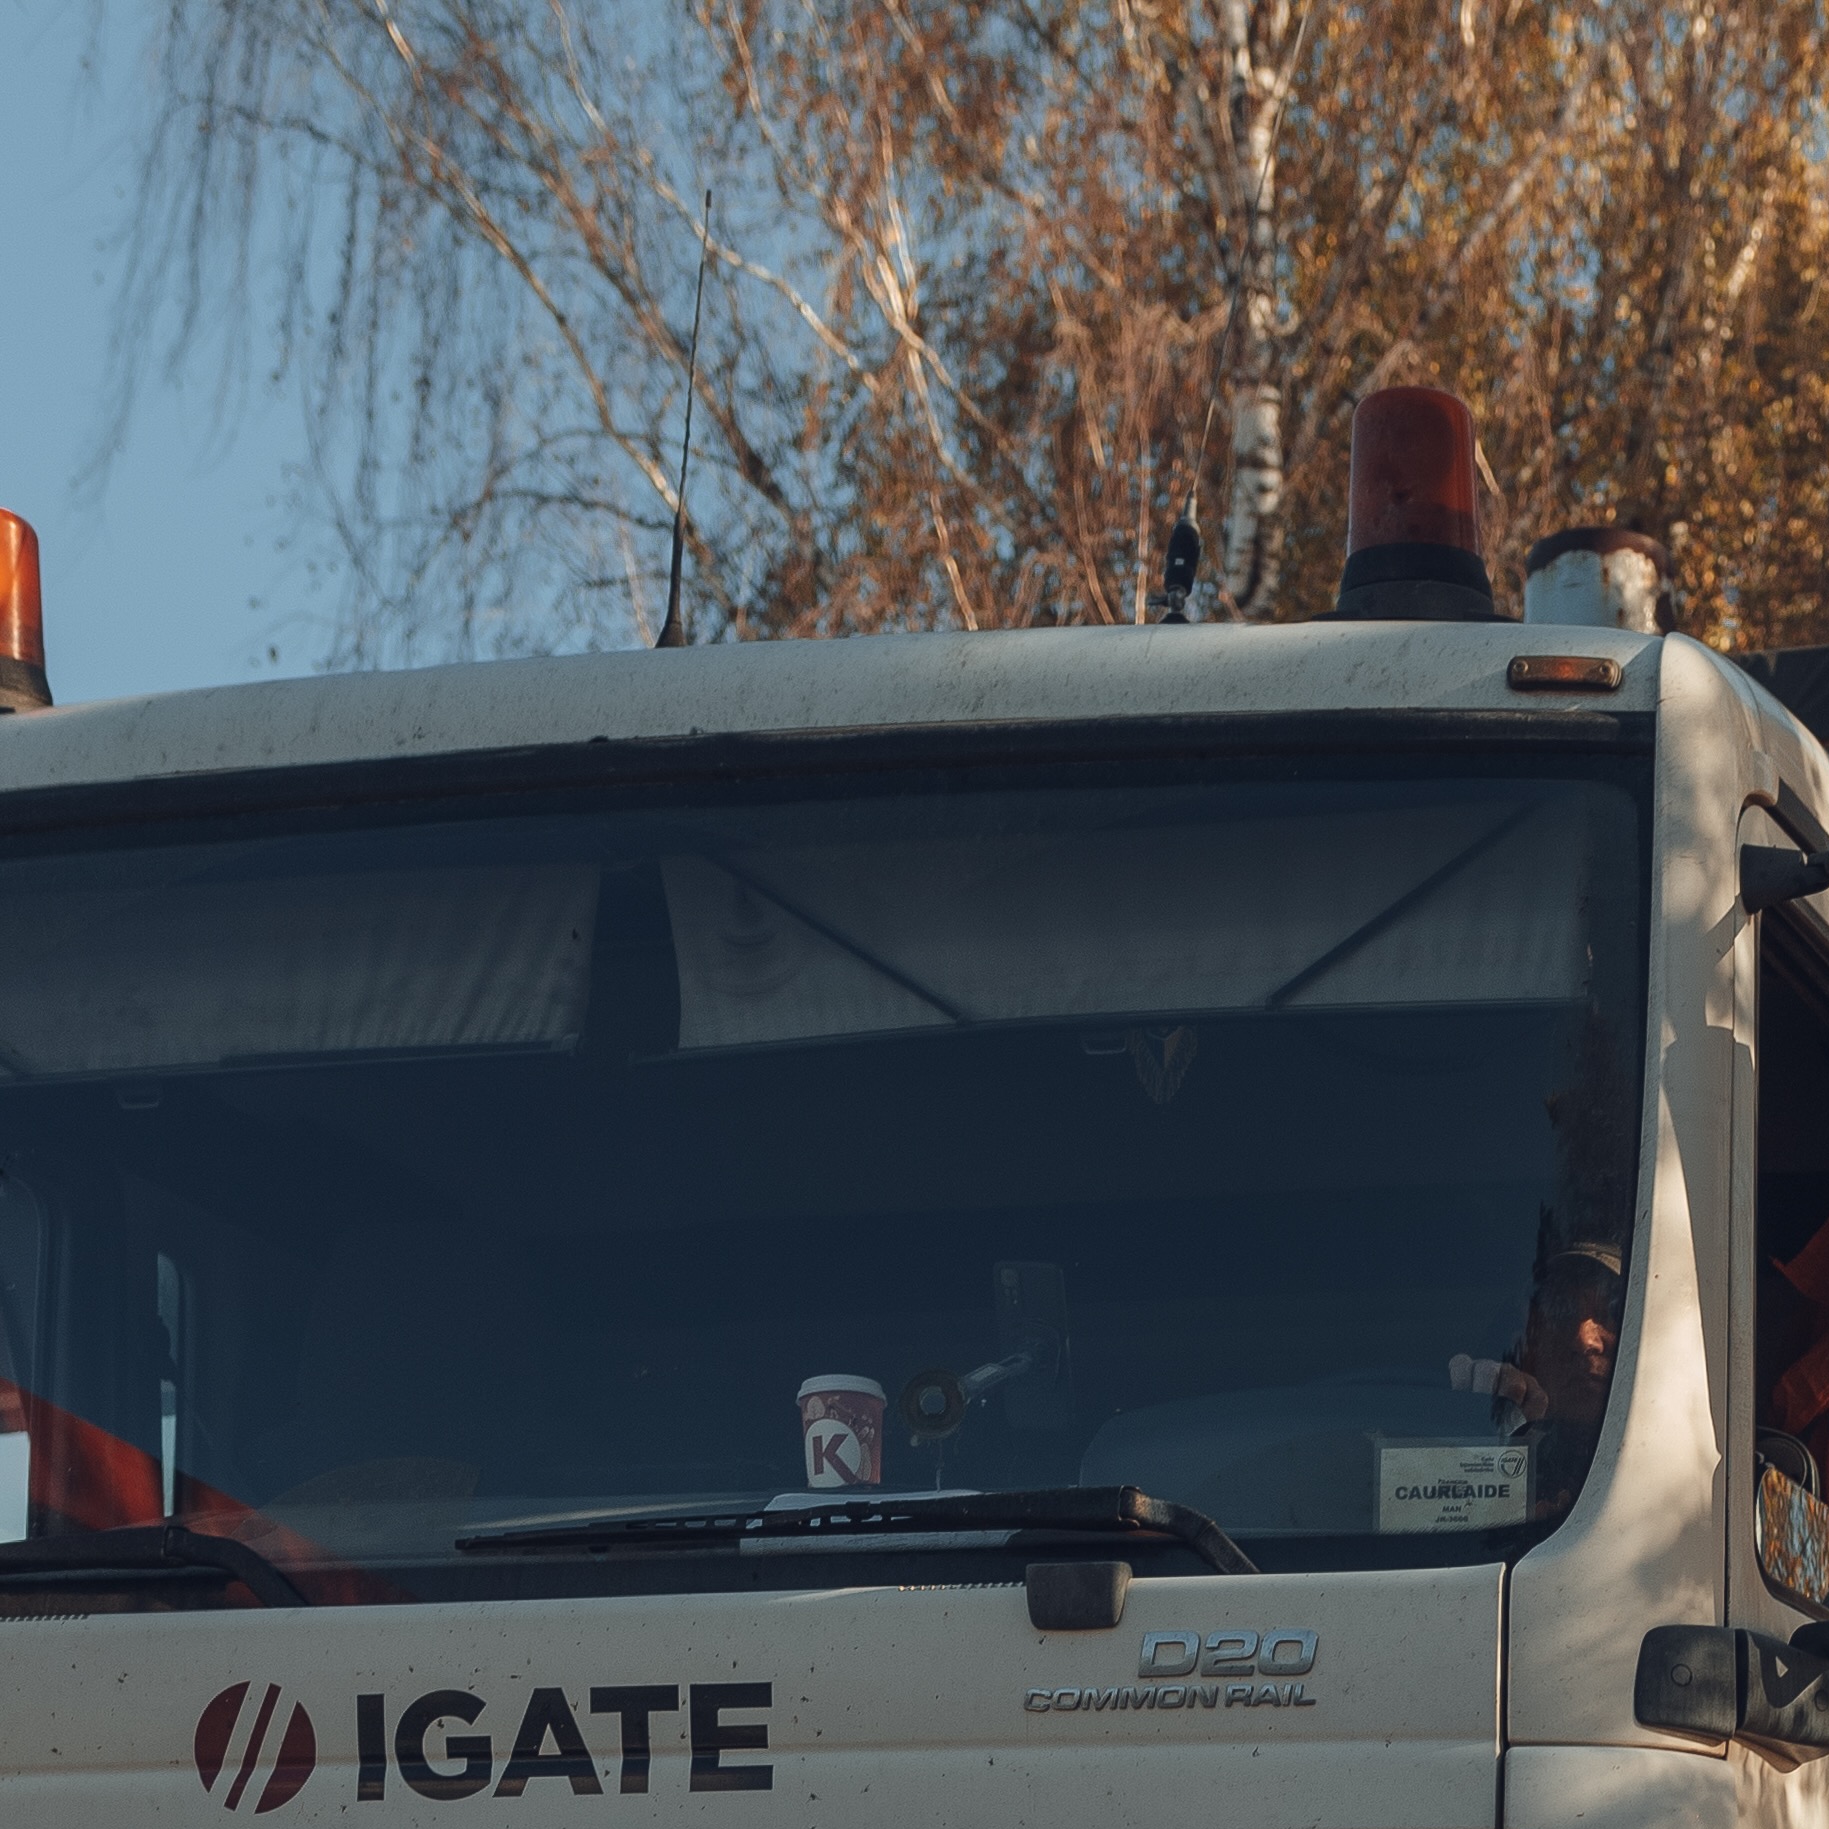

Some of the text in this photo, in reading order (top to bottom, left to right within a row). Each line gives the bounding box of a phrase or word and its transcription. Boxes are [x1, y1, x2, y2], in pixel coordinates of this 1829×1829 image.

[812, 1433, 859, 1485] K
[1395, 1484, 1511, 1500] CAURLAIDE
[1138, 1629, 1319, 1678] D20
[1024, 1682, 1317, 1712] COMMON RAIL
[356, 1681, 775, 1802] IGATE
